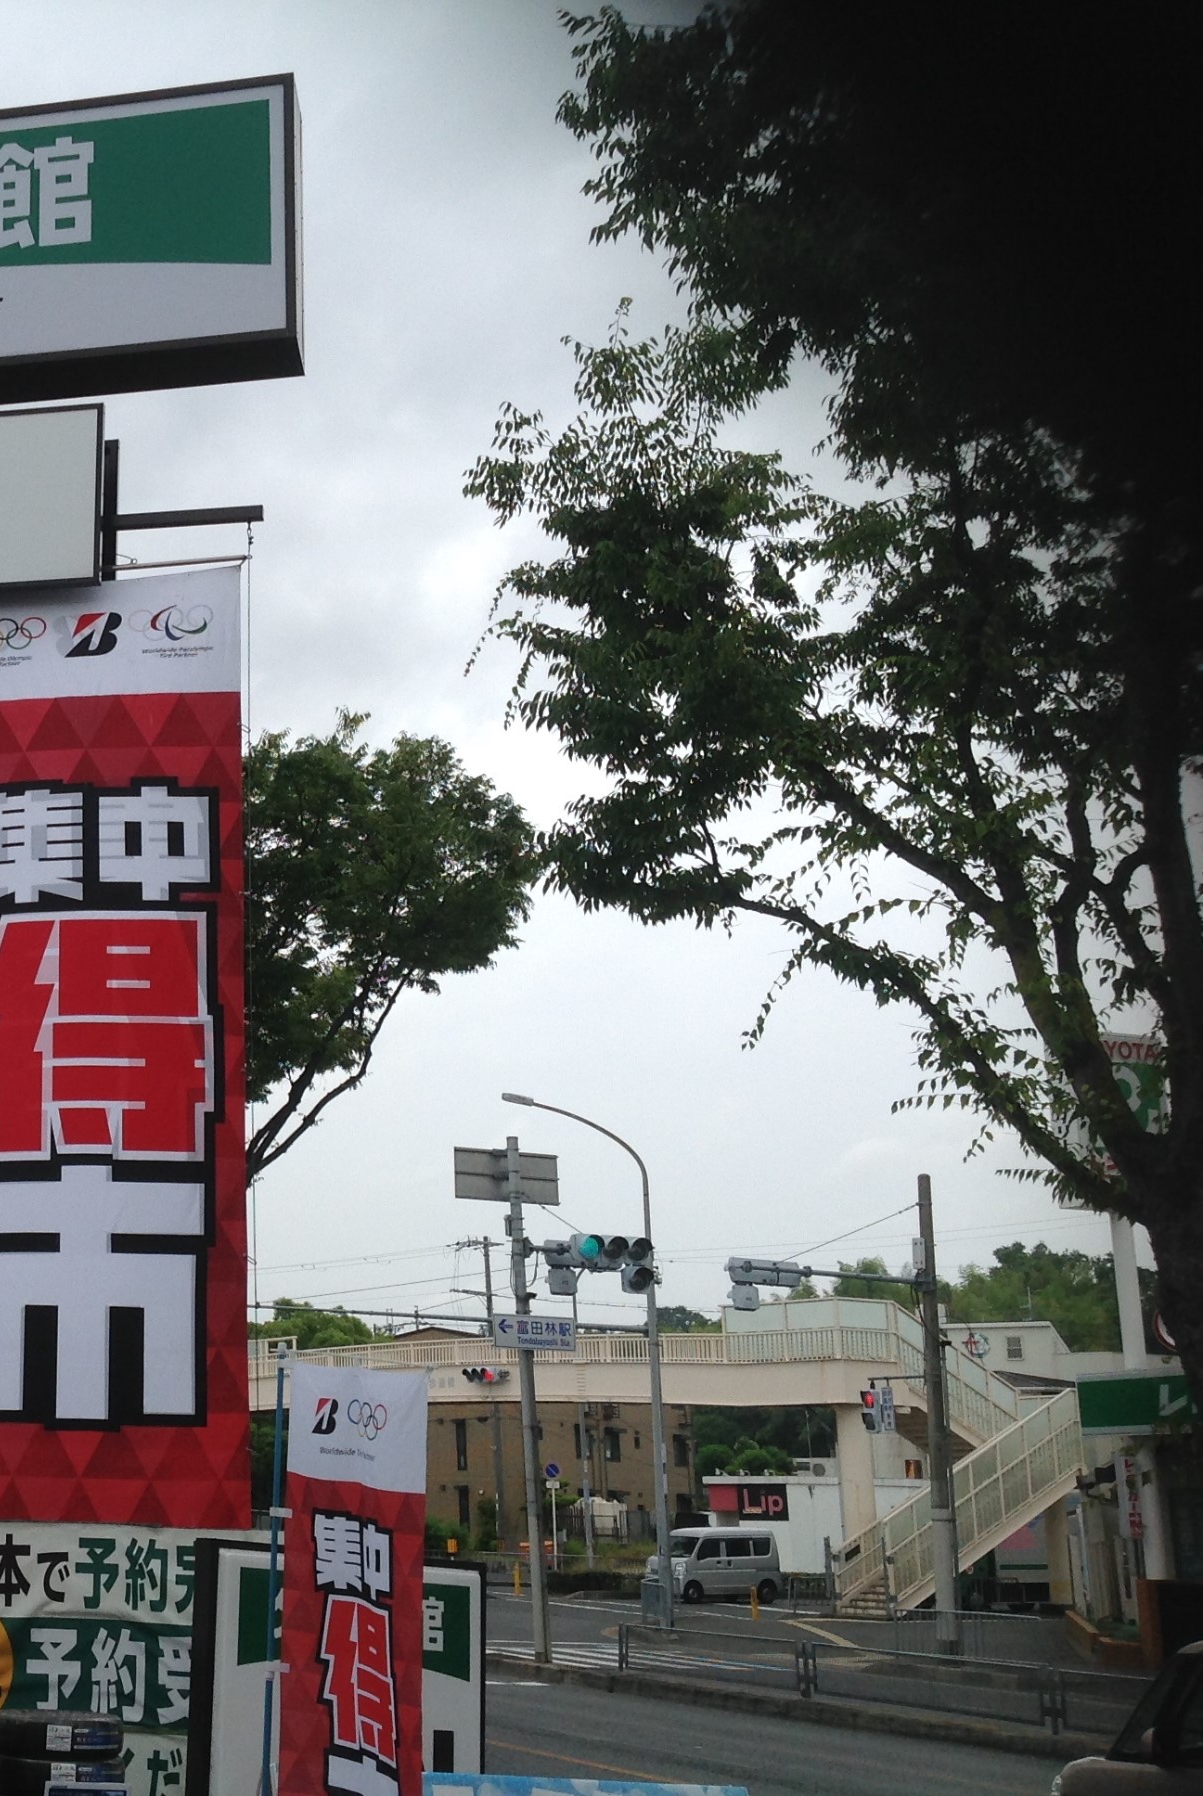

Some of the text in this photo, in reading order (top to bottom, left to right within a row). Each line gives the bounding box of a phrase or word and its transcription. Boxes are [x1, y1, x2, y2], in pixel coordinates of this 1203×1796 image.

[1104, 1040, 1159, 1060] YOTA
[516, 1319, 572, 1337] 富田林駅
[742, 1488, 785, 1516] Lip
